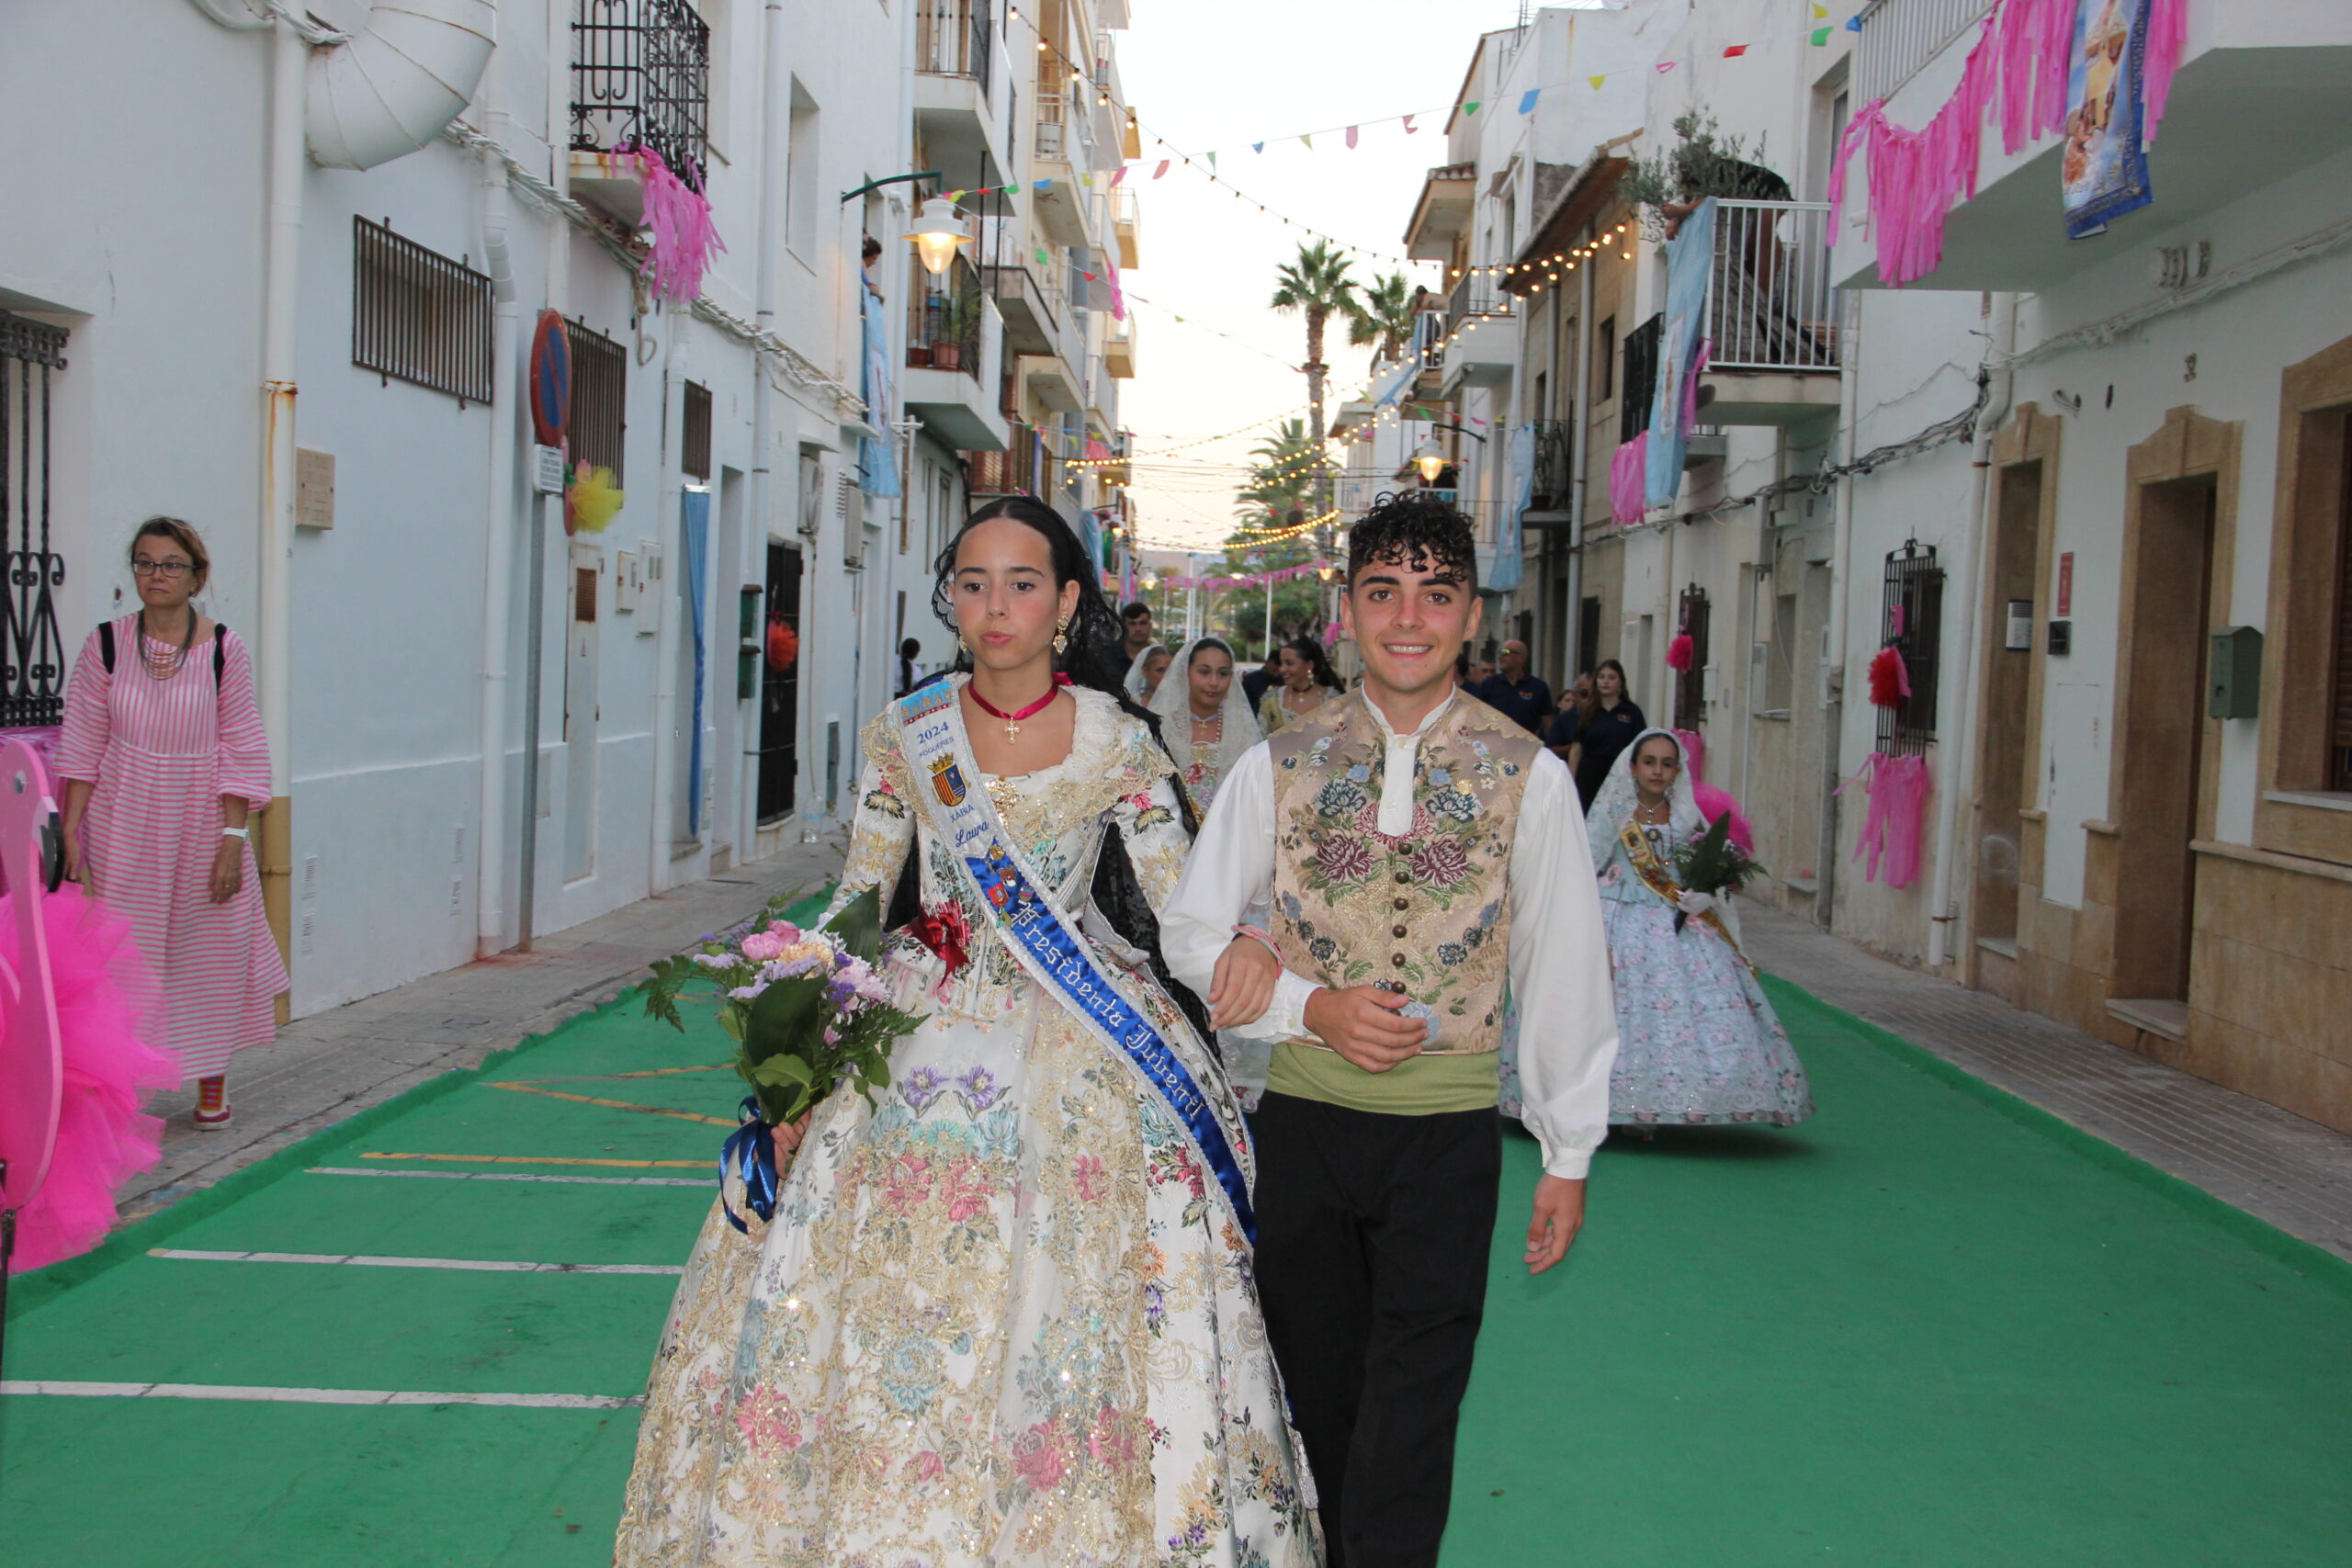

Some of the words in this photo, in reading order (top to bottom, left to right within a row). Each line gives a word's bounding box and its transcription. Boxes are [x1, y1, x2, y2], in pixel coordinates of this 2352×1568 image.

[917, 721, 949, 744] 2024
[919, 736, 955, 757] FOGUERES
[956, 820, 989, 848] Laura
[1011, 899, 1126, 1027] Presidenta
[1125, 1024, 1205, 1118] Juvenil
